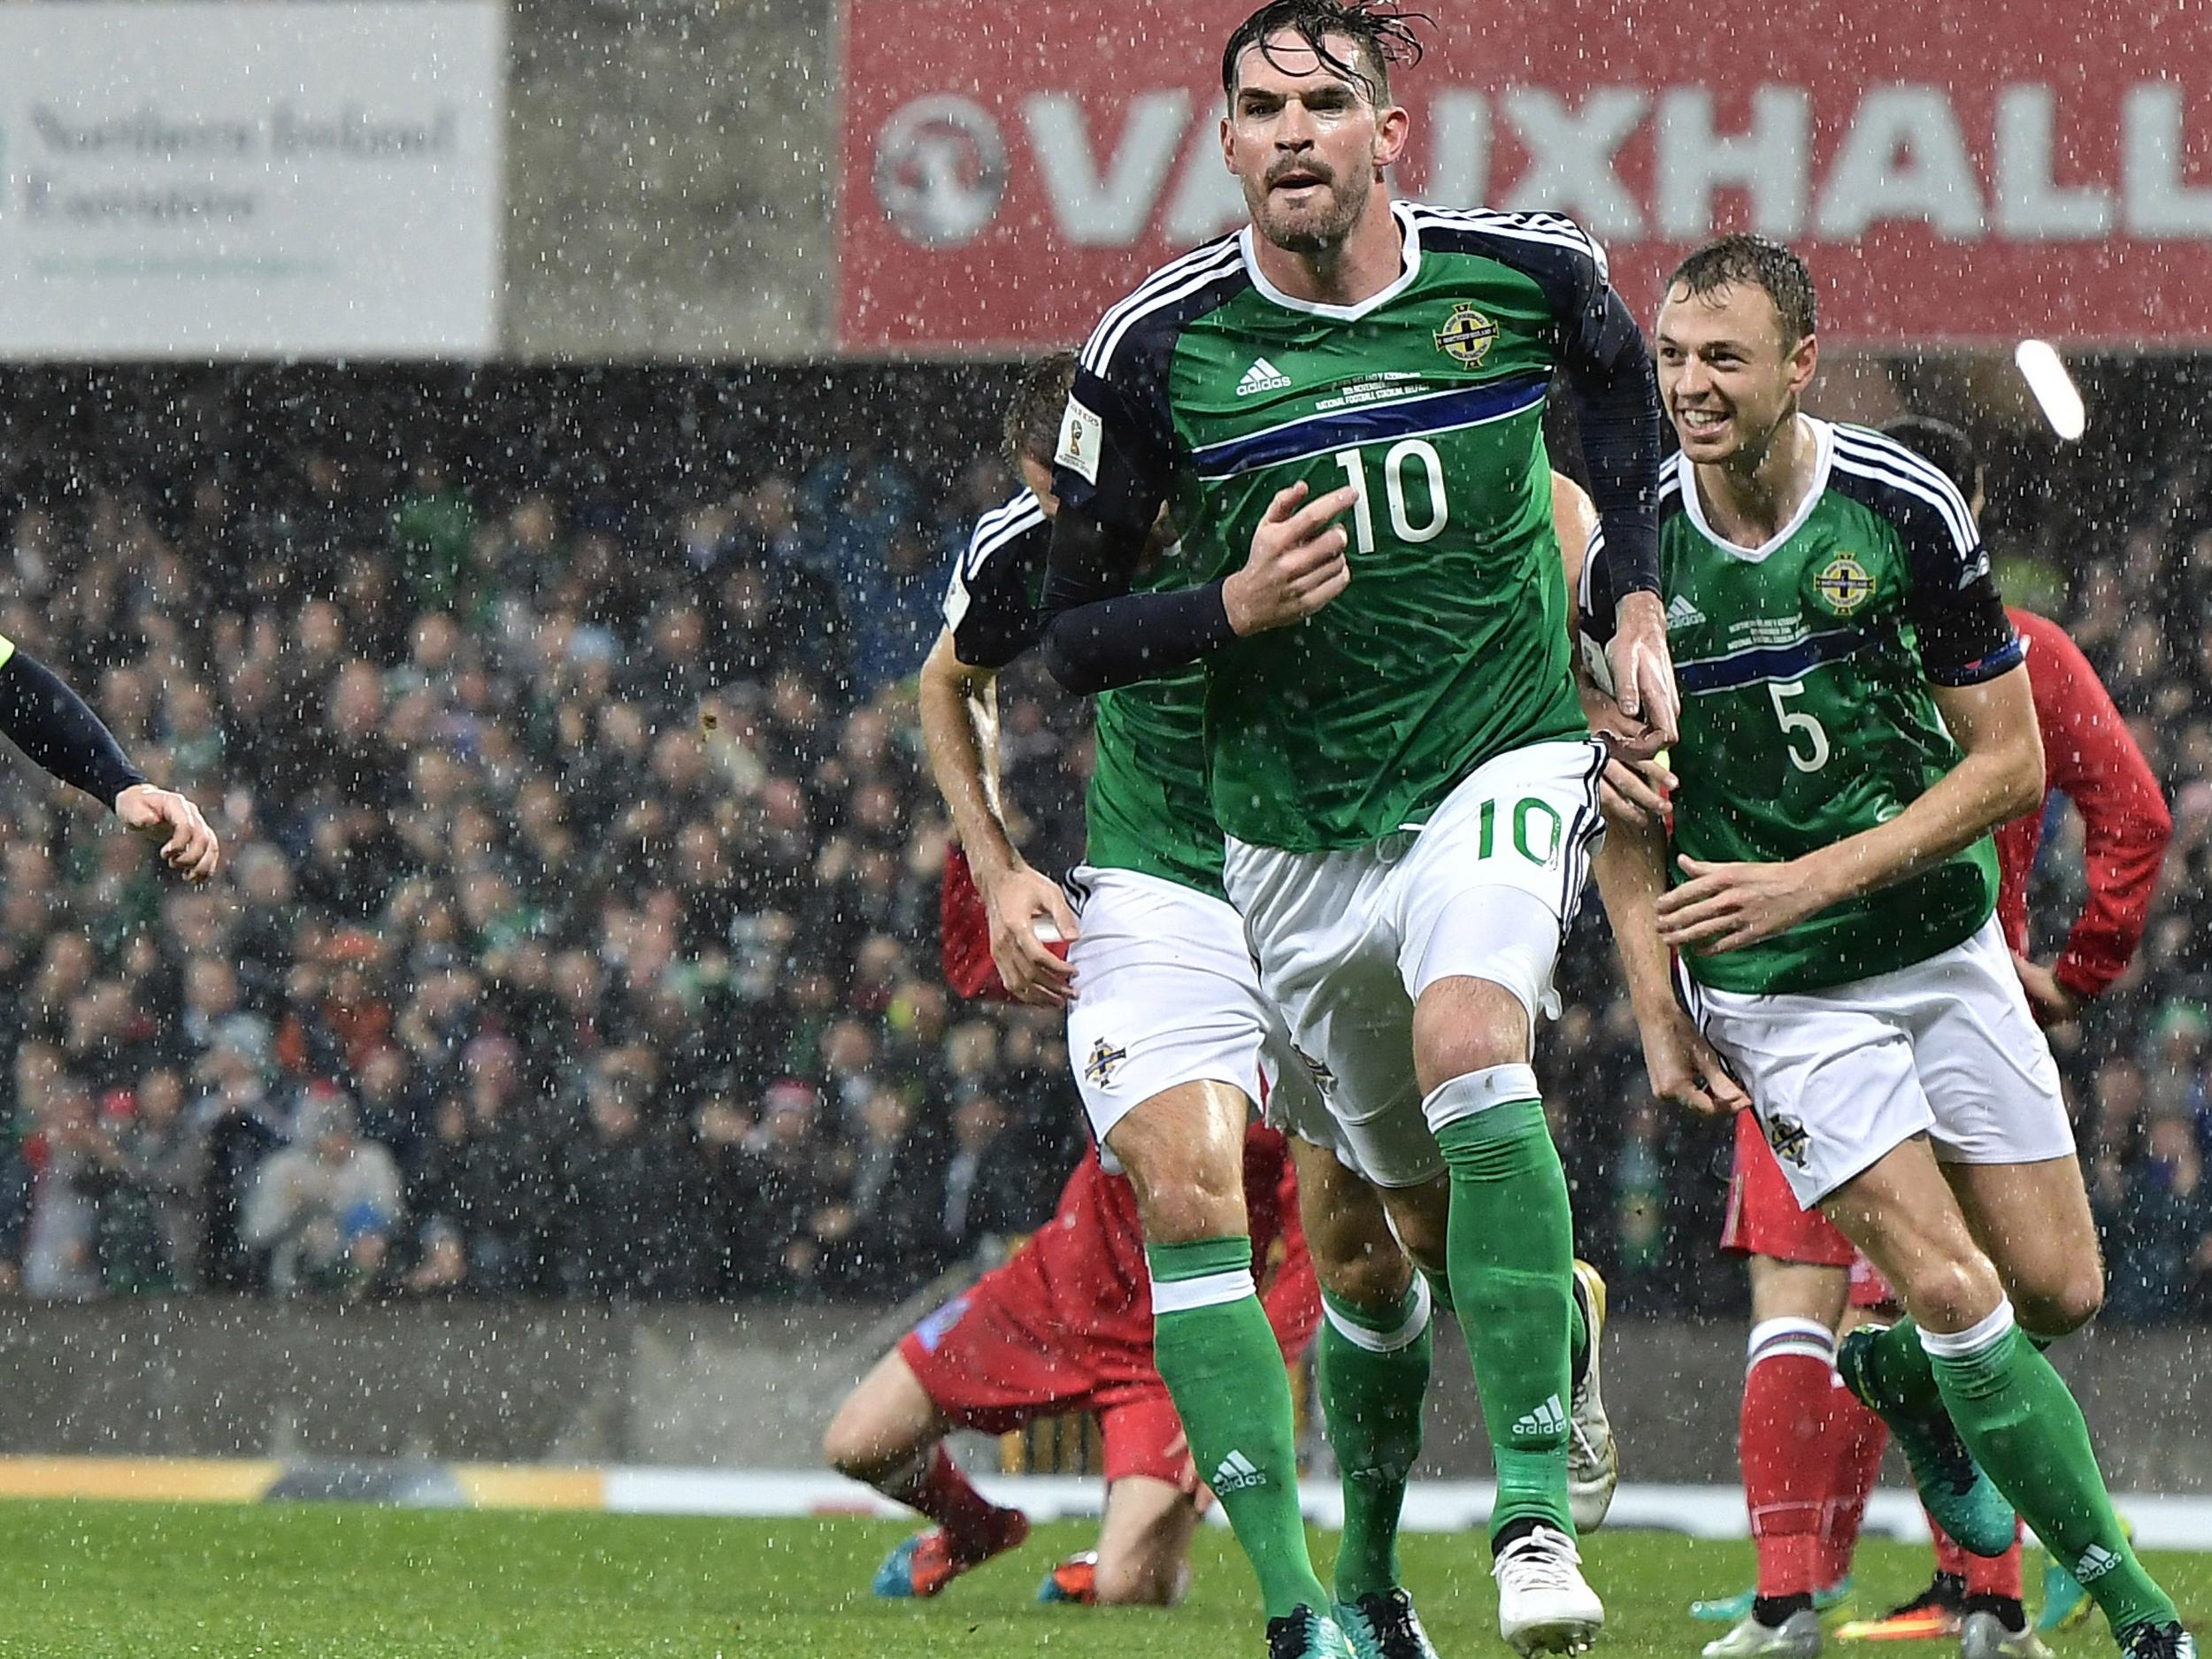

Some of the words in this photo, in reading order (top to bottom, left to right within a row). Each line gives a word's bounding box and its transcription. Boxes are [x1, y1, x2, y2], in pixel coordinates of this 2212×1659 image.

[1236, 376, 1291, 396] adidas
[1336, 440, 1448, 554] 10
[1768, 680, 1829, 772] 5
[1478, 797, 1562, 871] 10
[1216, 1472, 1266, 1496] adidas
